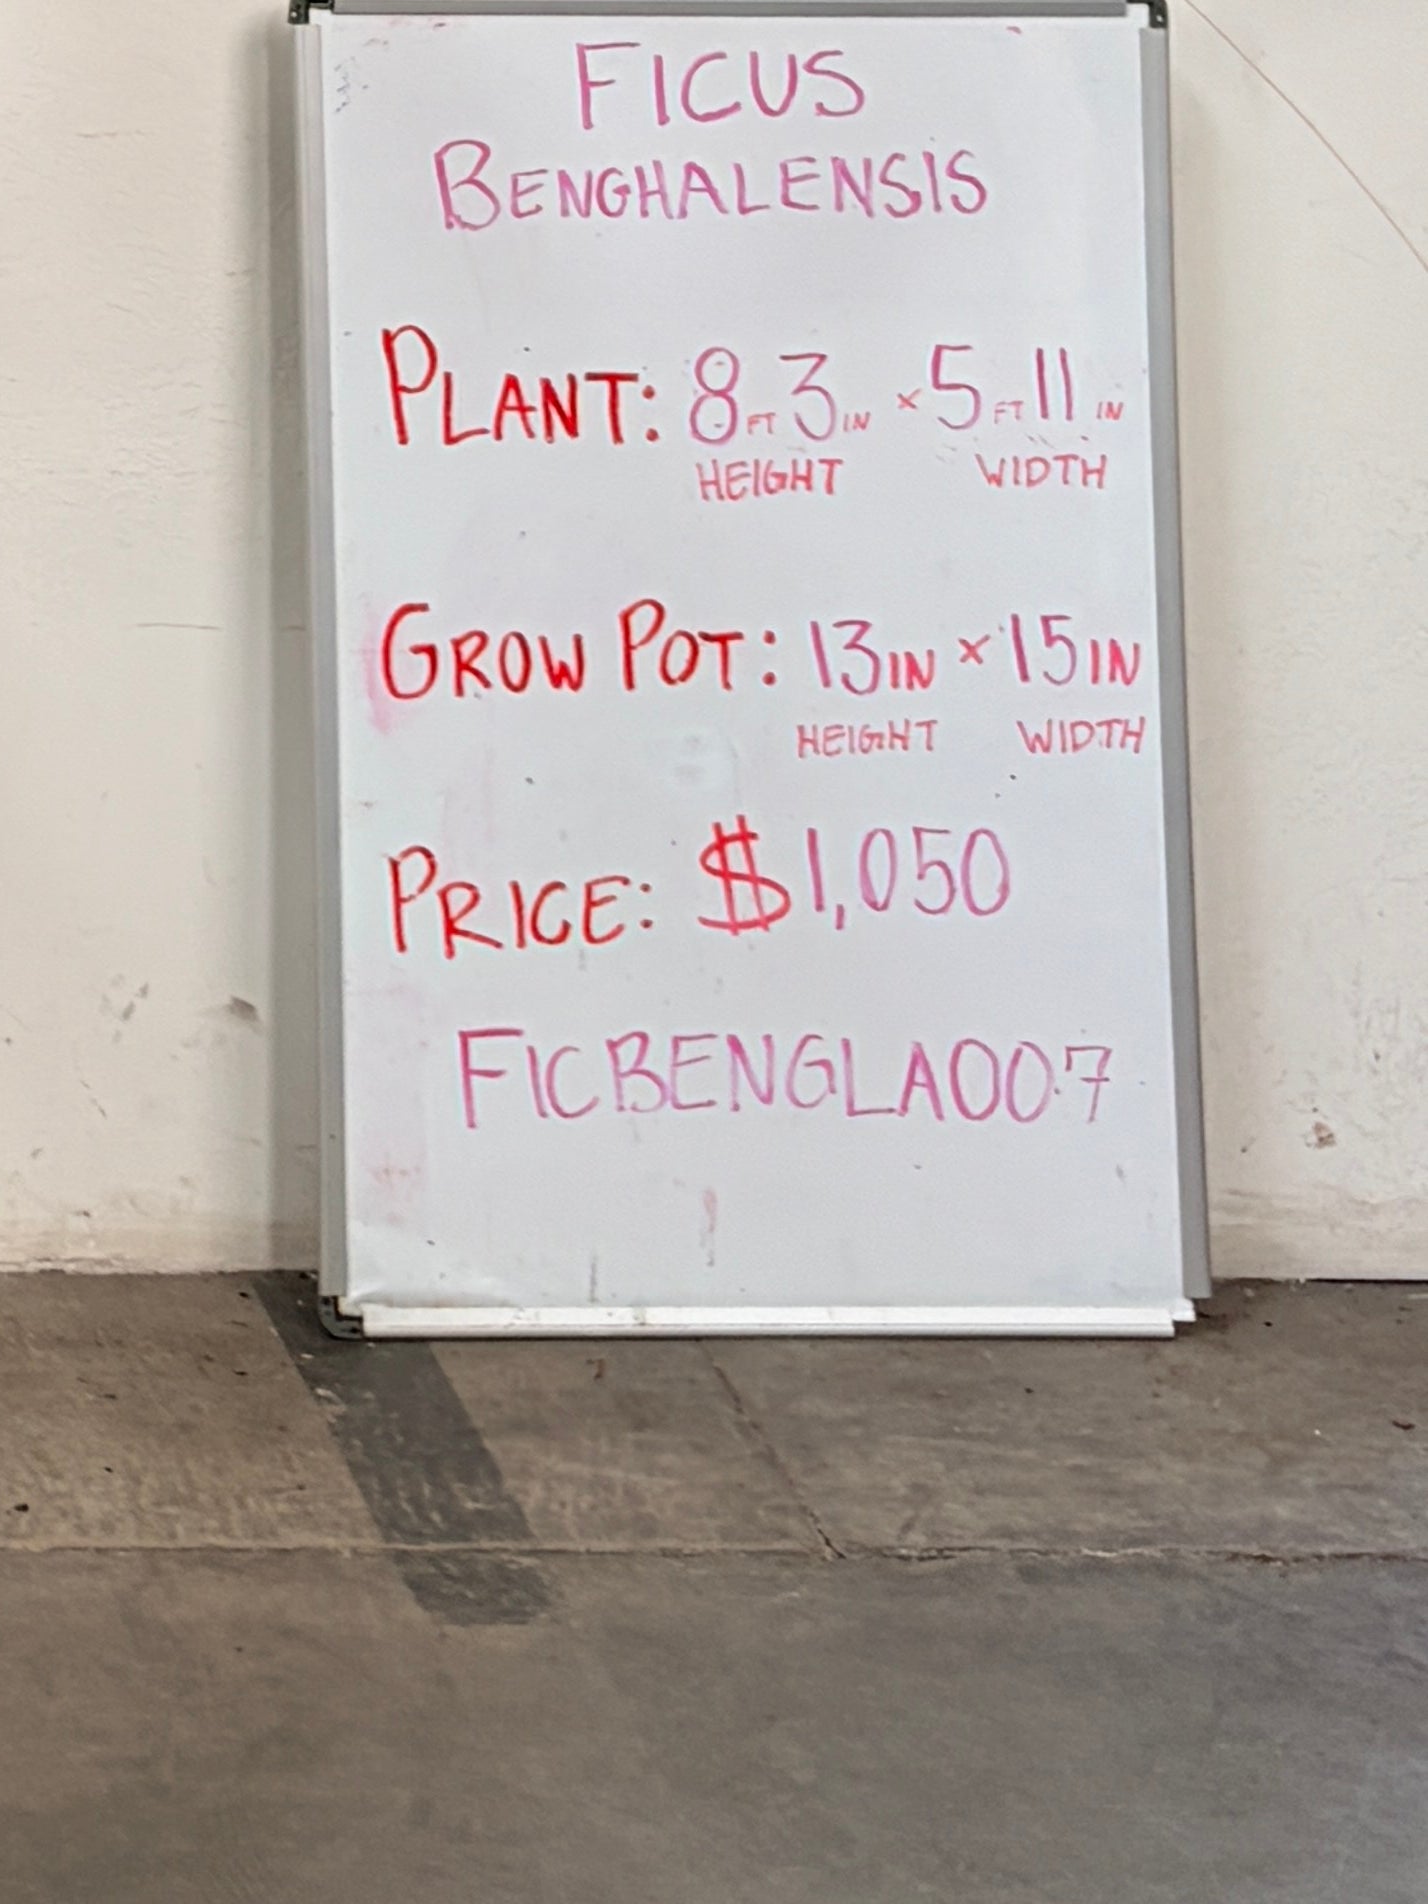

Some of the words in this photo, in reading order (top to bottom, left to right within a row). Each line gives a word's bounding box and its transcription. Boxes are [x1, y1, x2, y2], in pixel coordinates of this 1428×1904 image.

[575, 43, 865, 130] FICUS
[433, 139, 988, 231] BENGHALENSIS
[382, 324, 660, 447] PLANT:
[696, 457, 844, 501] HEIGHT
[976, 453, 1107, 489] WIDTH
[380, 604, 587, 700] GROW
[618, 598, 777, 693] POT:
[796, 720, 936, 758] HEIGHT
[1016, 717, 1145, 755] WIDTH
[387, 845, 653, 959] PRICE:
[697, 813, 1010, 936] $1,050
[457, 1027, 1111, 1129] FICBENGLA007
